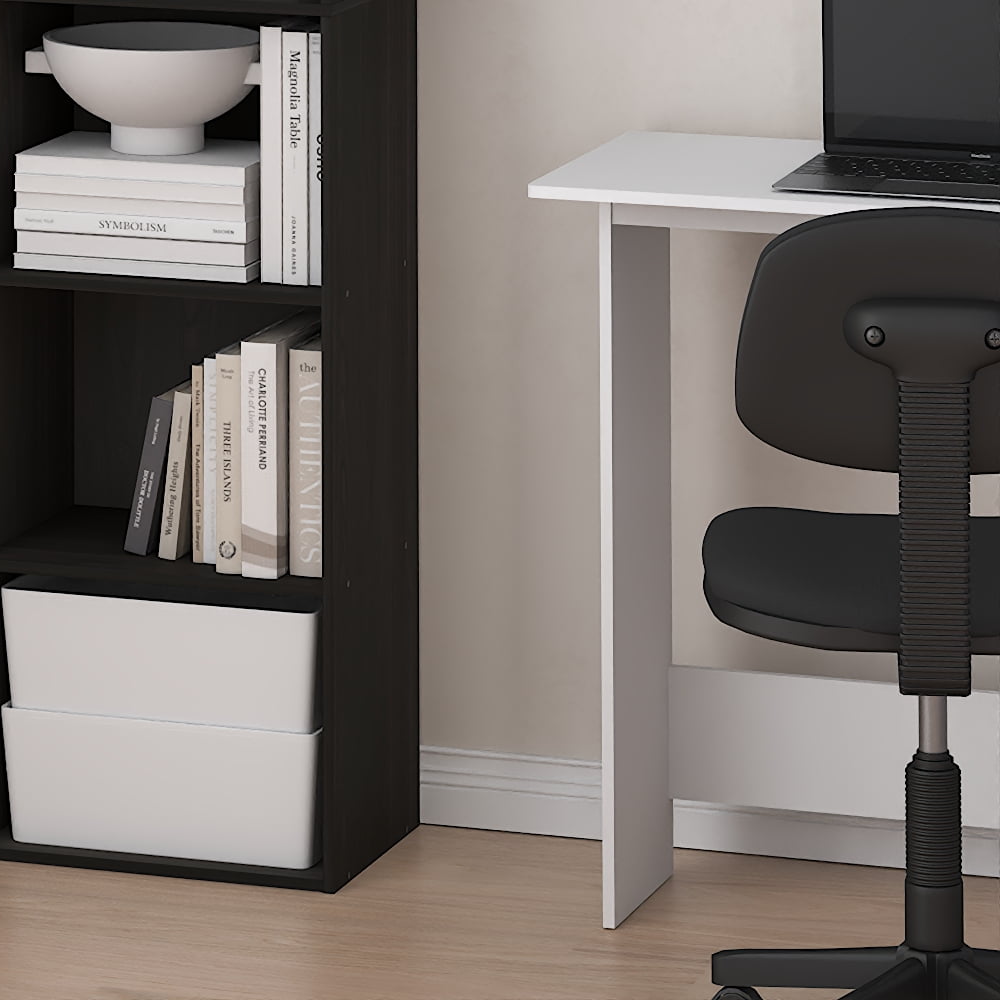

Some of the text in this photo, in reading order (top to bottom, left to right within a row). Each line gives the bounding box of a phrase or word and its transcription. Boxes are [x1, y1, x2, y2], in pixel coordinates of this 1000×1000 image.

[288, 50, 301, 148] Magnolia Table
[98, 219, 168, 232] SYMBOLISM
[246, 370, 256, 433] The Art of Living
[300, 363, 317, 373] the
[258, 368, 267, 470] CHARLOTTE PERRIAND
[164, 461, 180, 536] Wuthering Heights
[223, 422, 232, 502] THREE ISLANDS
